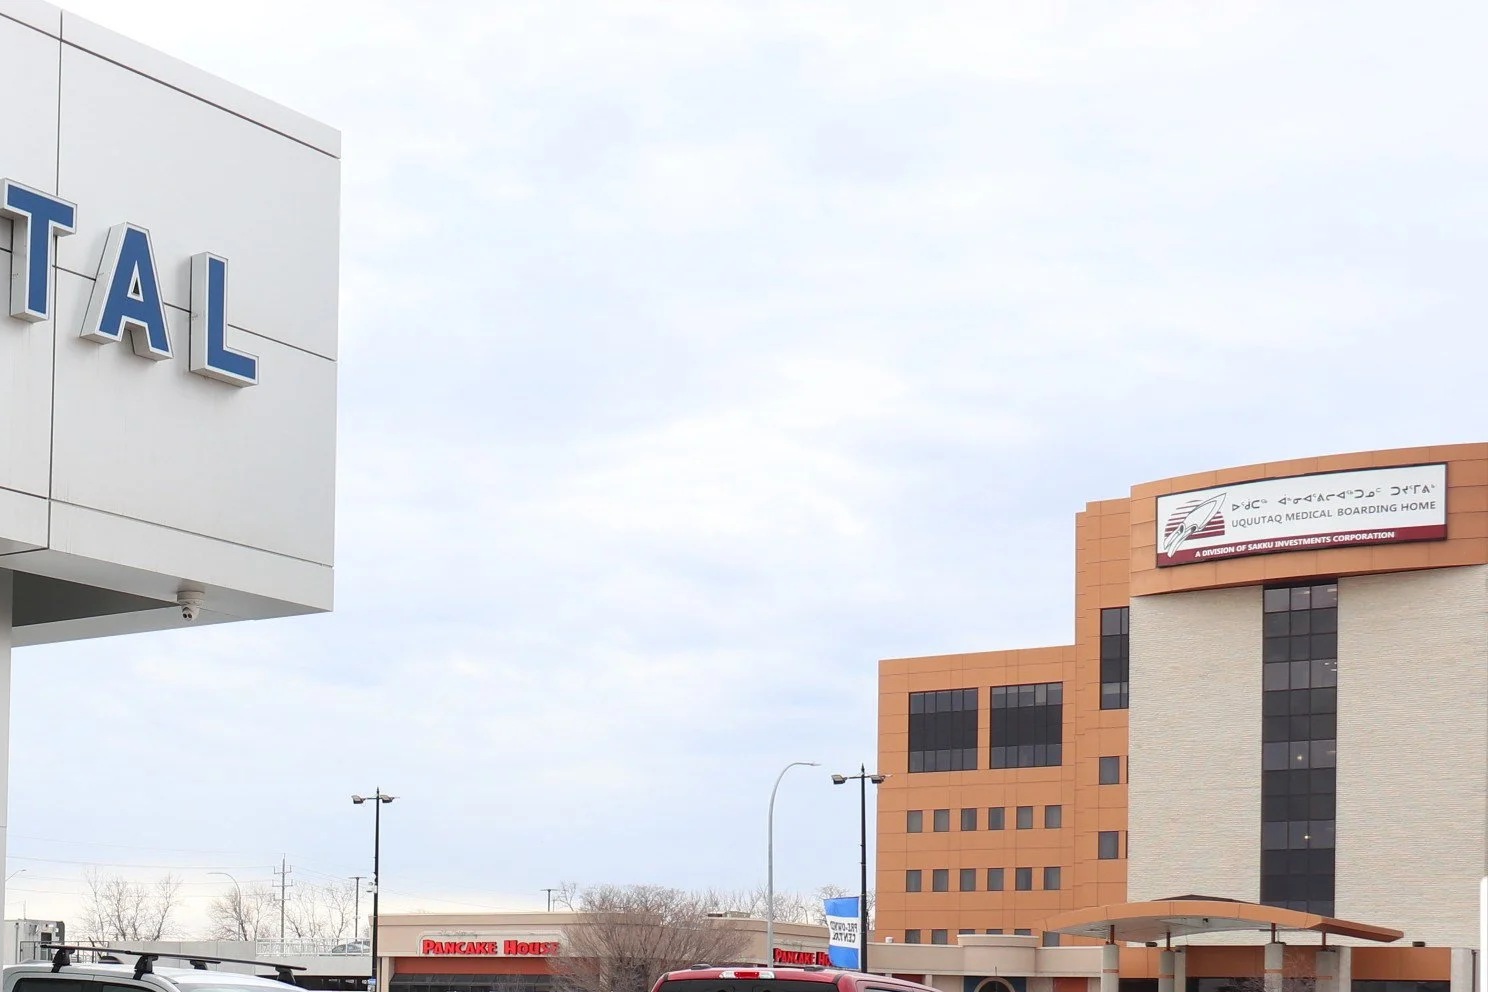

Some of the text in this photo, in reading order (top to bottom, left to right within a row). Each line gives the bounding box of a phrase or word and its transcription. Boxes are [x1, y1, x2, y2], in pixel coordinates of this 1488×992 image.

[1231, 500, 1437, 528] UQUUTAQ MEDICAL BOARDING HOME
[1194, 531, 1395, 558] A DIVISION OF SAKKU INVESTMENTS CORPORATION
[422, 939, 560, 956] PANCAKE HOUSE
[773, 948, 816, 965] PANCAKE
